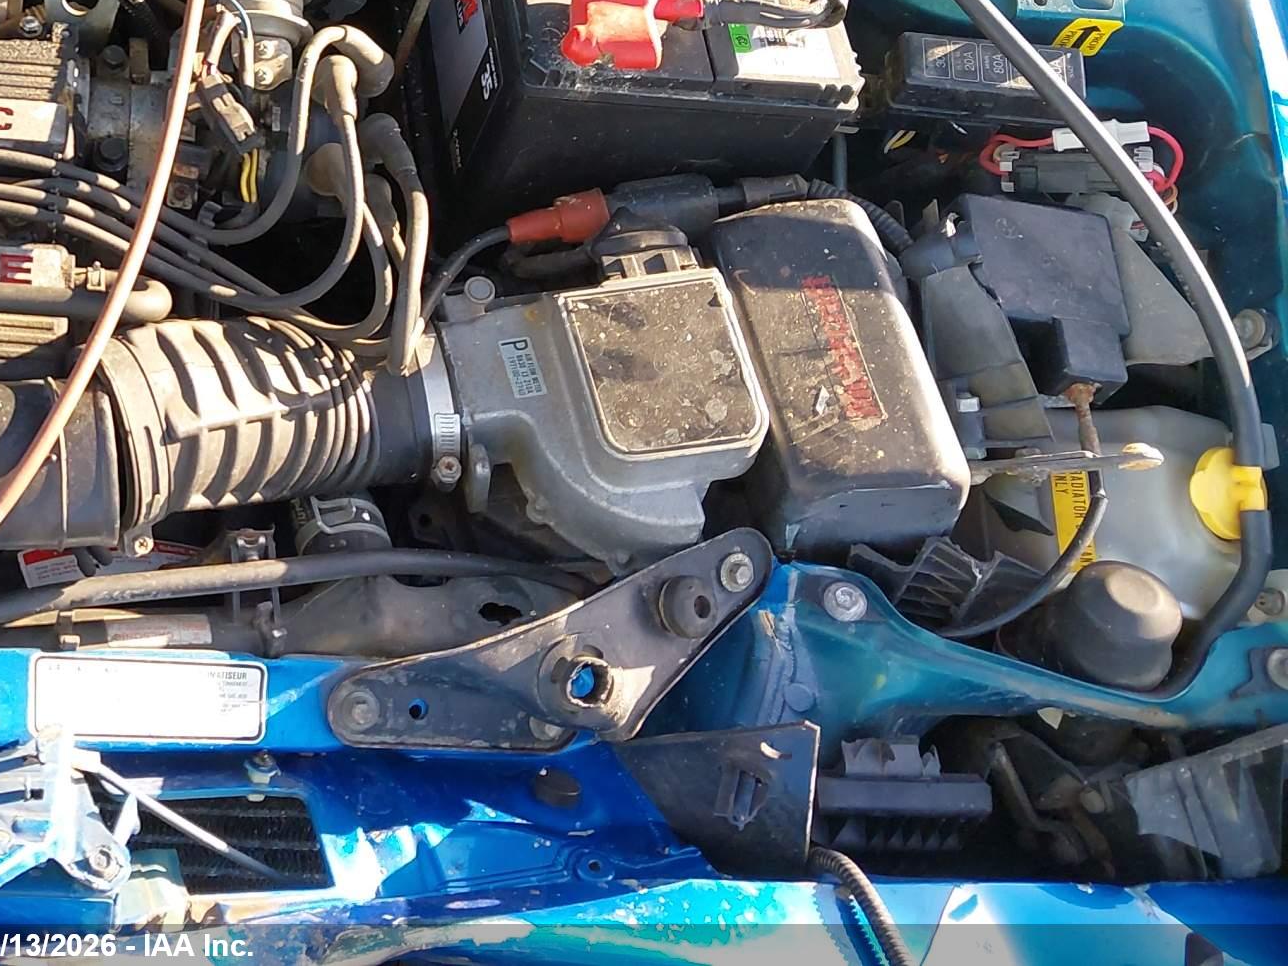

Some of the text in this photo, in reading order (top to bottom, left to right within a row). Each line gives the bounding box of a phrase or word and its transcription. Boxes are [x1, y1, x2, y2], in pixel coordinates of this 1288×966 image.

[1086, 32, 1105, 51] PROP
[963, 51, 975, 71] 20A
[501, 339, 529, 351] P
